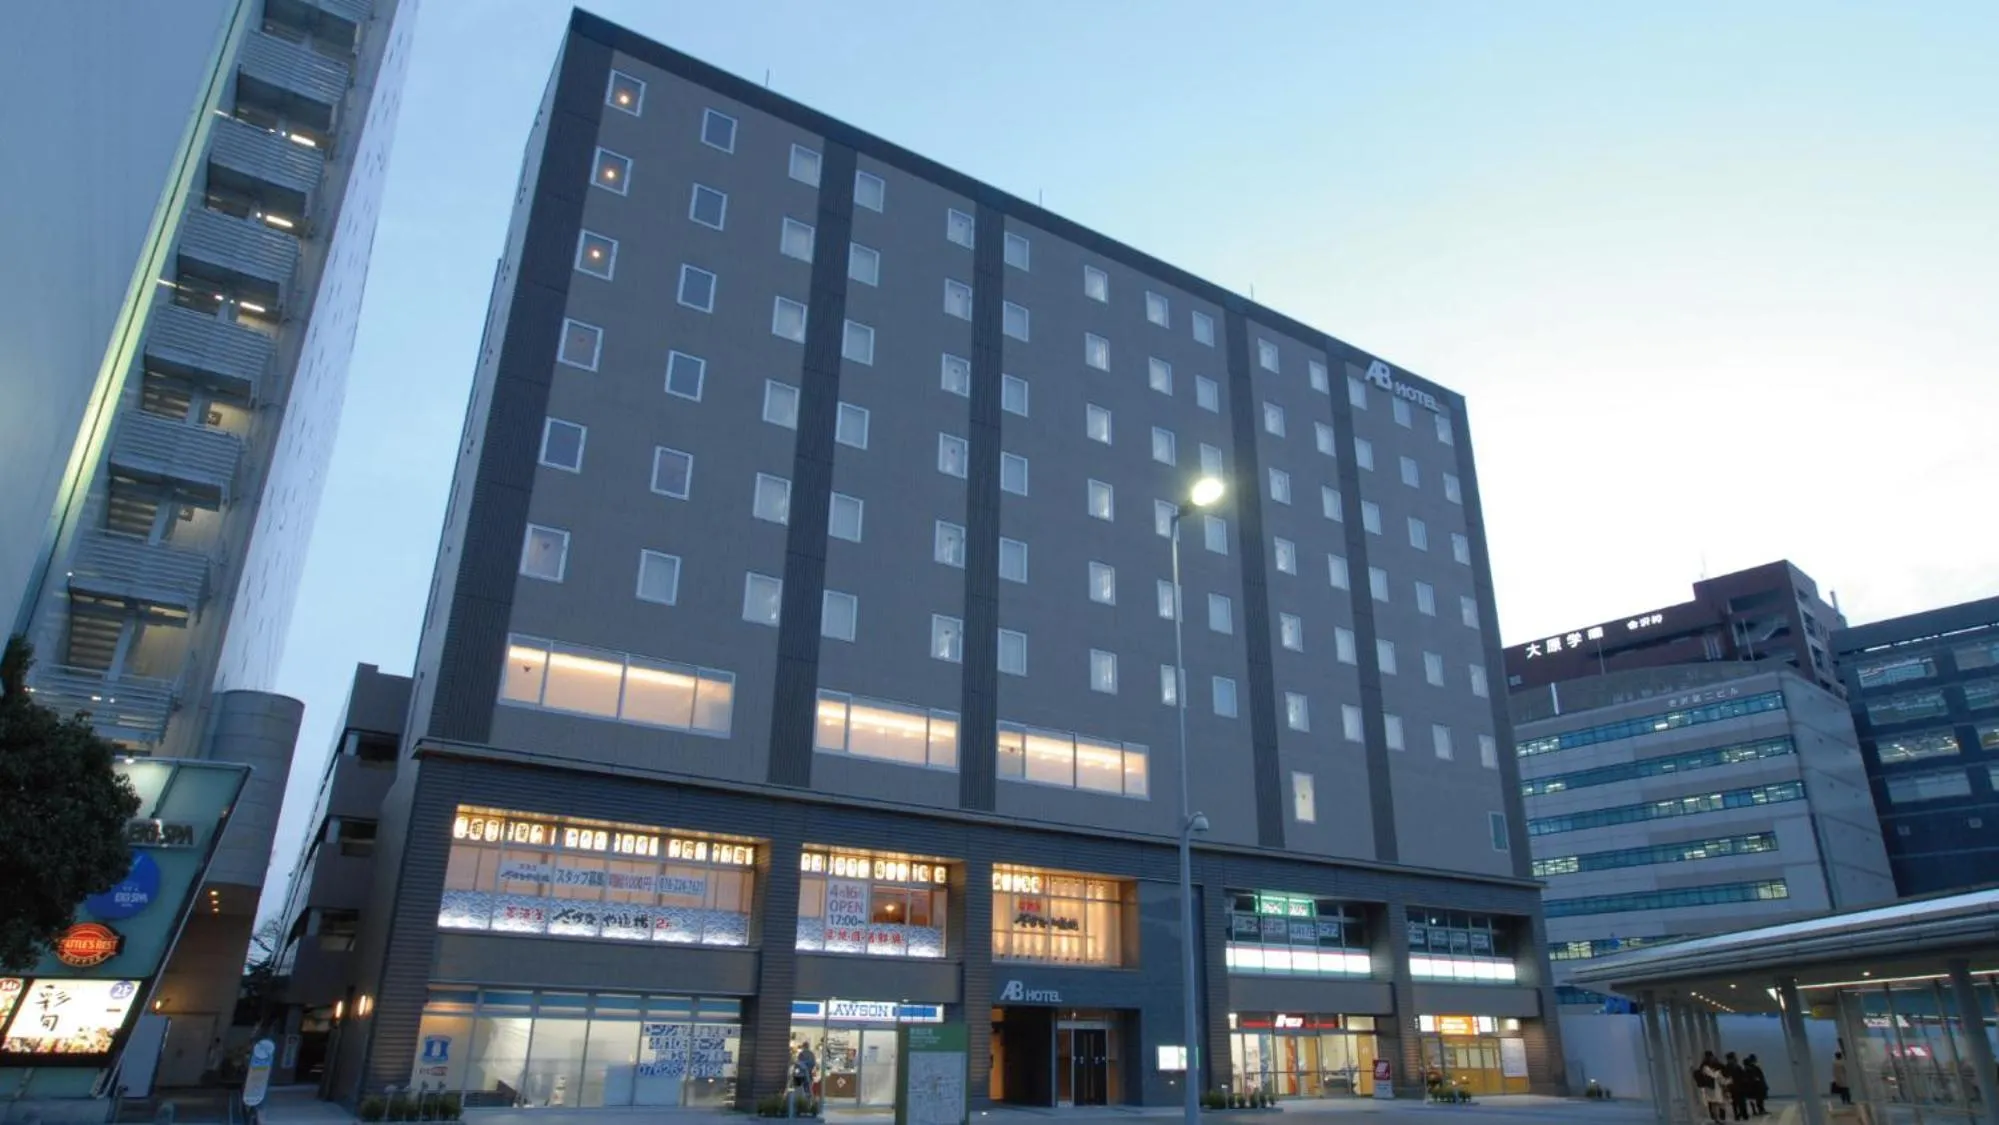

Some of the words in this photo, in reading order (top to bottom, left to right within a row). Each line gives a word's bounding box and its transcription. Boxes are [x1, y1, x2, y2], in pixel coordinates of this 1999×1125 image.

[1364, 360, 1393, 391] AB
[1395, 381, 1440, 412] HOTEL
[829, 899, 864, 914] OPEN
[1000, 979, 1025, 1000] AB
[1026, 989, 1062, 1003] HOTEL
